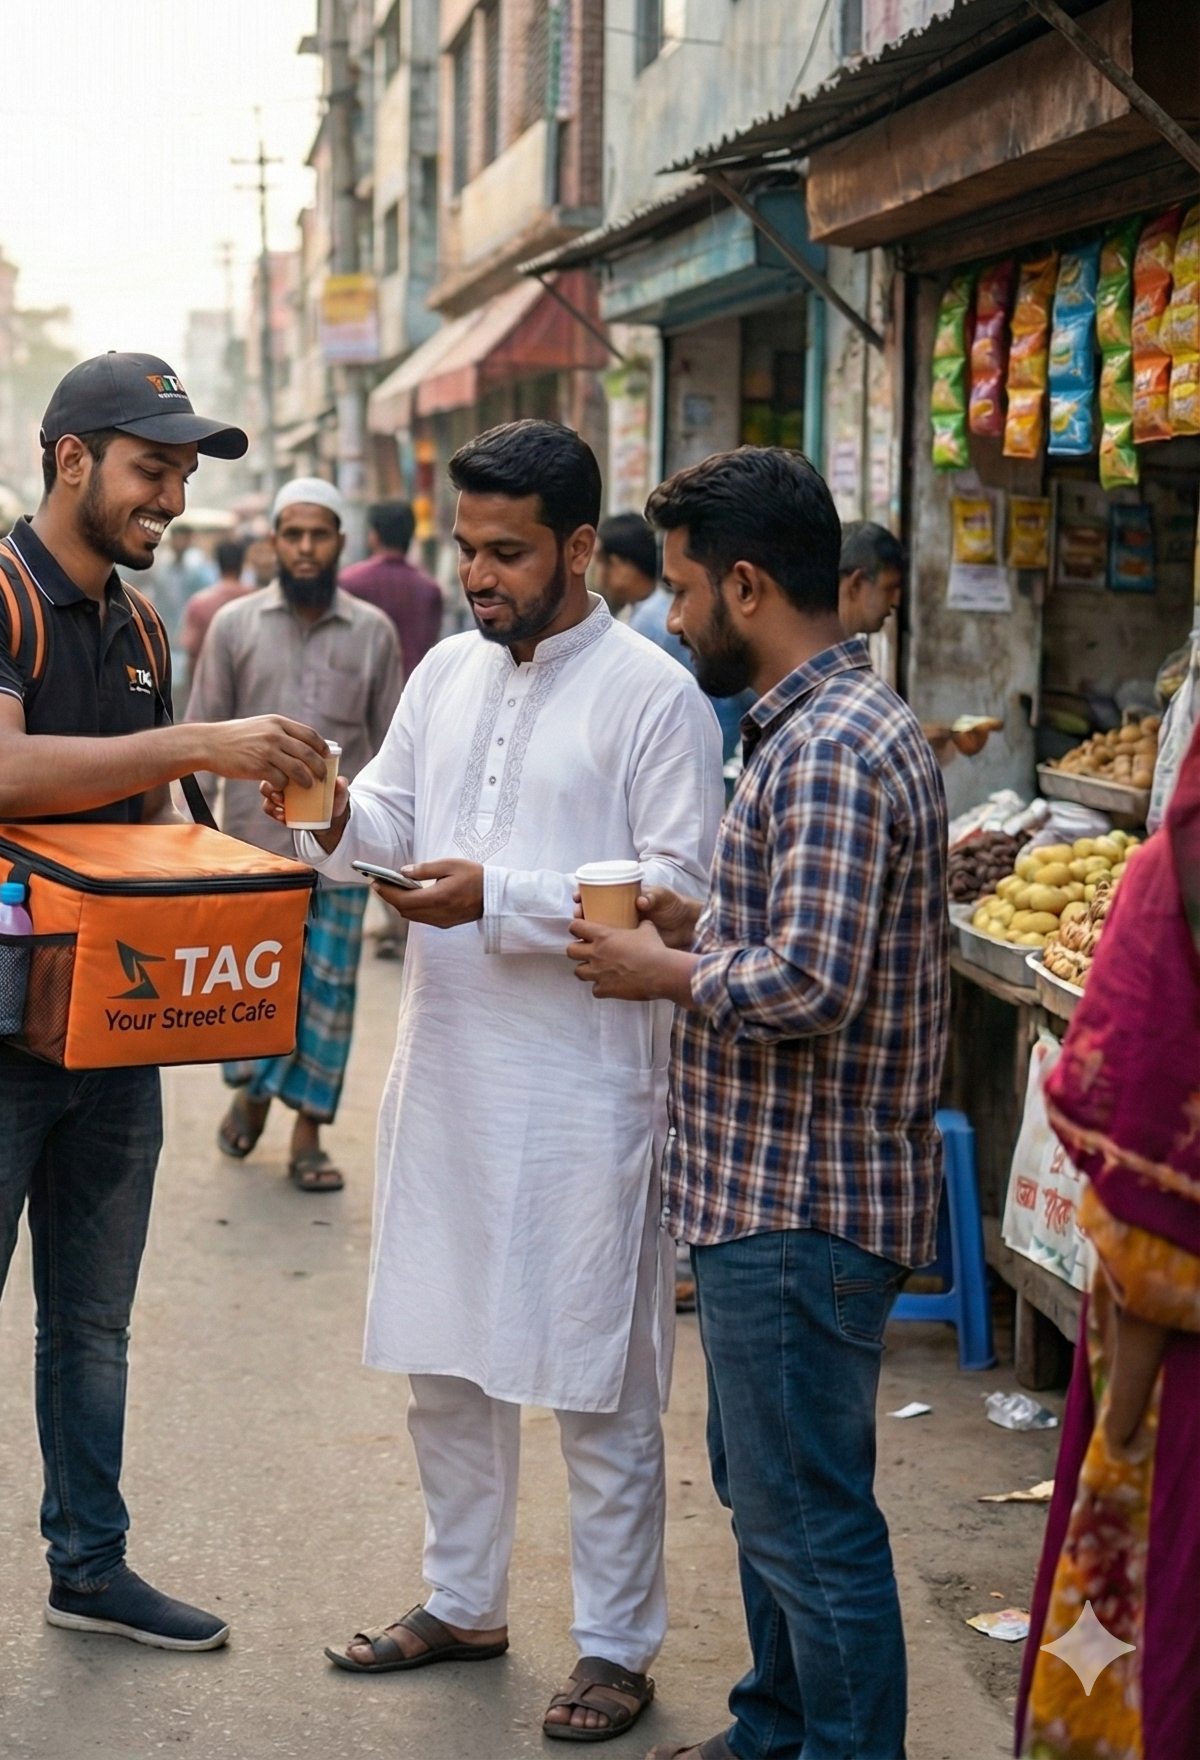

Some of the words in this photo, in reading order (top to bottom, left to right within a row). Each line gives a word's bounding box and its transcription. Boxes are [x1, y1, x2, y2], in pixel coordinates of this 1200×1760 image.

[174, 940, 283, 997] TAG
[105, 1009, 157, 1031] Your
[161, 1004, 227, 1029] Street
[231, 998, 277, 1023] Cafe
